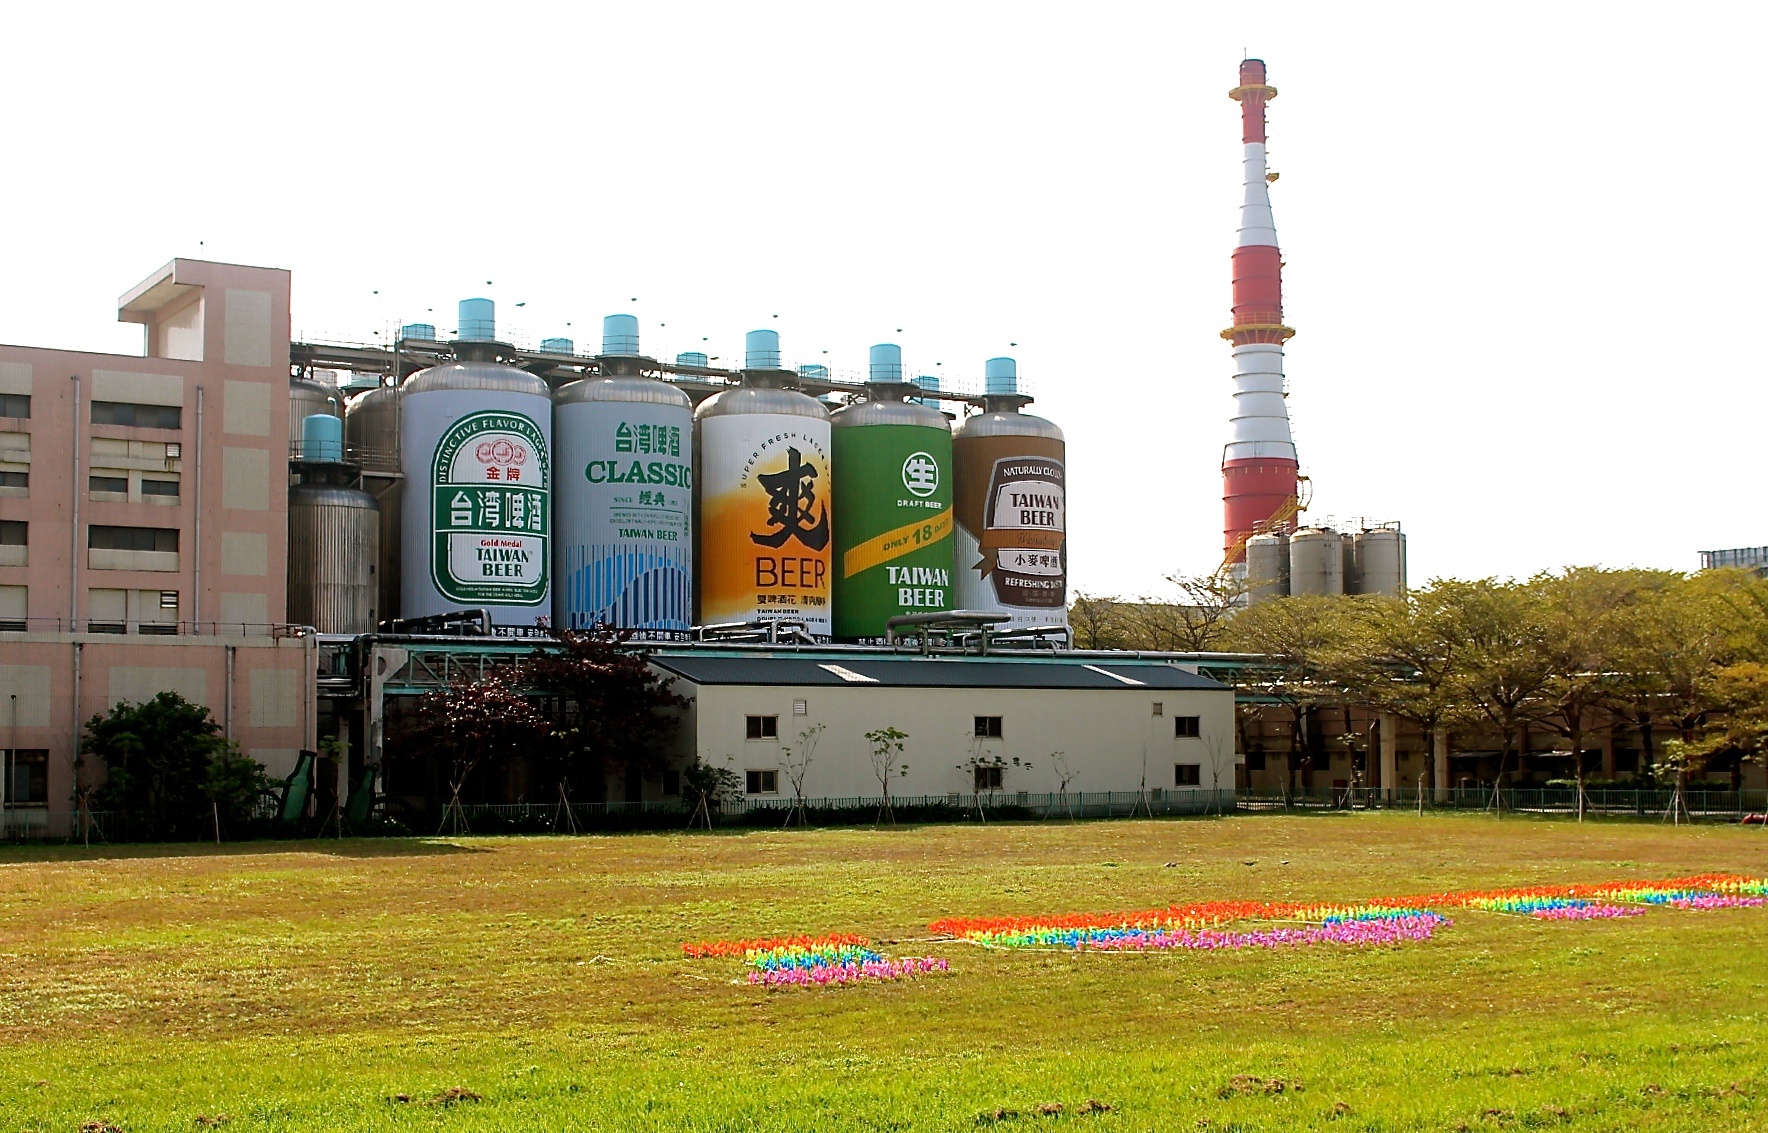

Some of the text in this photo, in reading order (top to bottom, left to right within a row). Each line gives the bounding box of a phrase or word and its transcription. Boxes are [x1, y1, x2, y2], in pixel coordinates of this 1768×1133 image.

[439, 422, 478, 482] DISTINCTIVE
[483, 420, 525, 431] FLAVOR
[740, 452, 759, 488] SUPER
[761, 433, 796, 450] FRESH
[486, 466, 520, 481] 金牌
[585, 460, 691, 489] CLASSIC
[906, 458, 936, 490] 生
[1003, 466, 1042, 477] NATURALLY
[750, 445, 830, 551] 爽
[925, 501, 942, 509] BEER
[1010, 493, 1059, 510] TAIWAN
[1020, 510, 1055, 526] BEER
[618, 528, 678, 541] TAIWAN BEER
[883, 536, 909, 551] ONLY
[912, 525, 932, 545] 18
[481, 539, 522, 548] Gold Medal
[476, 548, 529, 563] TAIWAN
[483, 563, 523, 577] BEER
[756, 557, 826, 589] BEER
[885, 566, 949, 587] TAIWAN
[1004, 577, 1050, 589] REFRESHING
[898, 588, 945, 607] BEER
